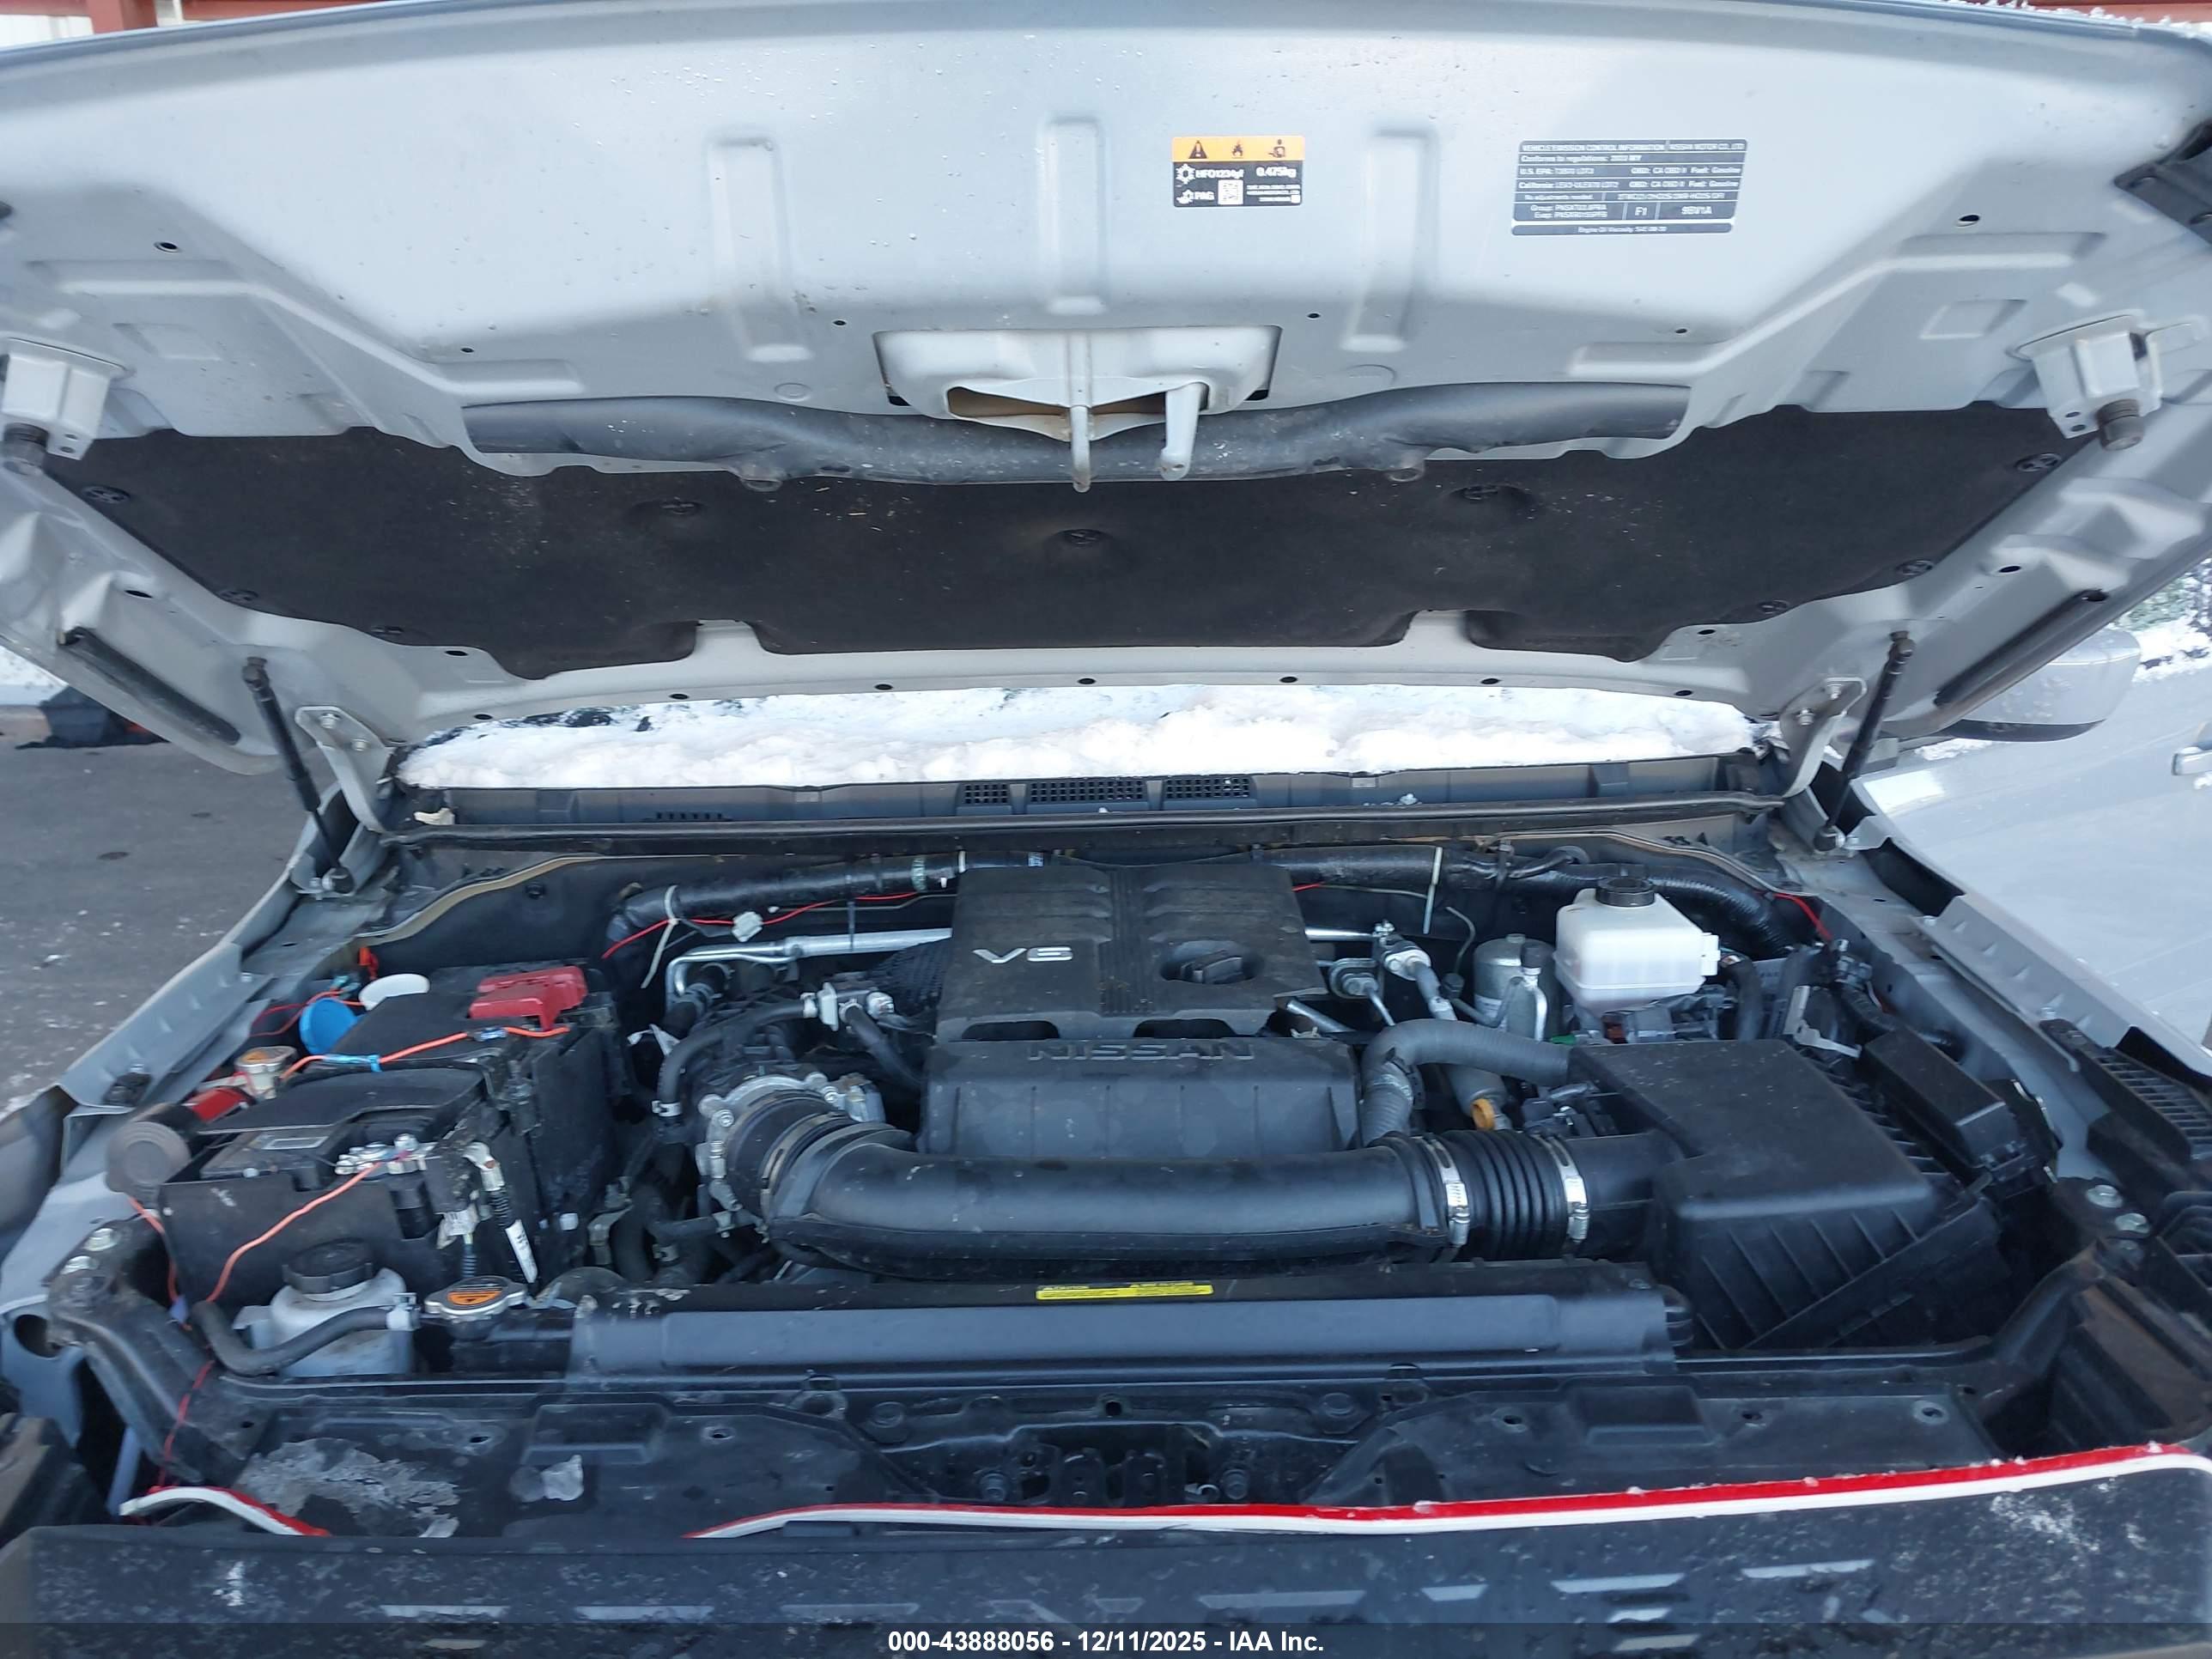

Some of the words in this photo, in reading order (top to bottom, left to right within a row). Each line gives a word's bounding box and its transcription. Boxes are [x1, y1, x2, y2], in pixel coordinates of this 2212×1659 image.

[1194, 191, 1215, 201] PAG
[1634, 206, 1648, 216] F1
[973, 946, 1073, 963] V6
[1028, 1043, 1255, 1060] NISSAN
